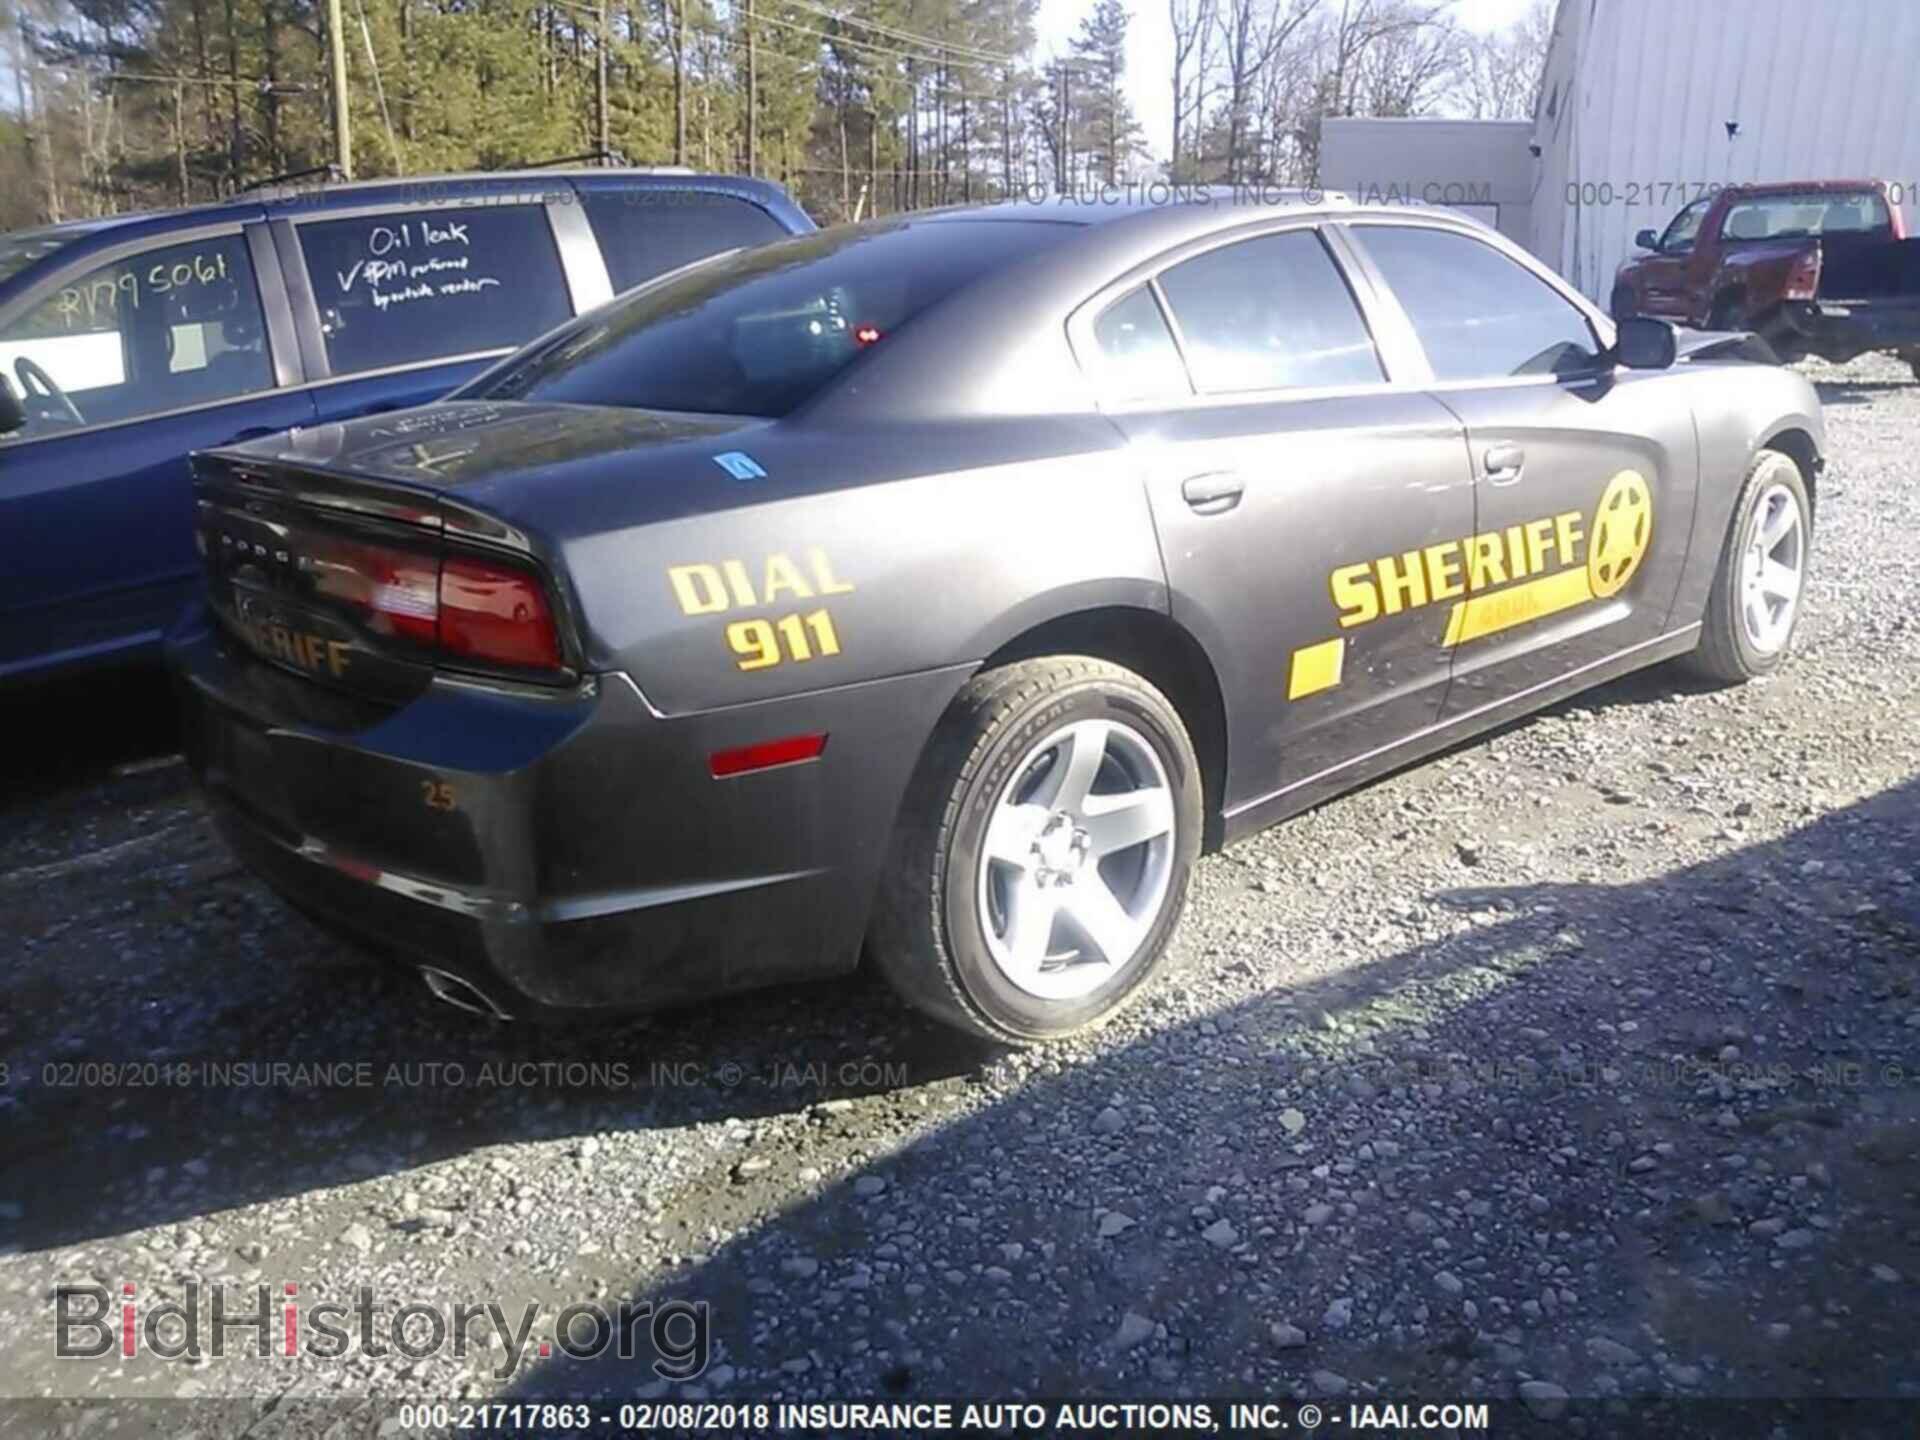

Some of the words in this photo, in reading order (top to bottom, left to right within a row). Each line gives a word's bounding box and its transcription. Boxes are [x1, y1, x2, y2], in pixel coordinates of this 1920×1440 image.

[370, 223, 410, 255] Oil
[421, 221, 470, 246] leak
[667, 545, 856, 616] DIAL
[1329, 511, 1585, 629] SHERIFF
[727, 608, 841, 671] 911
